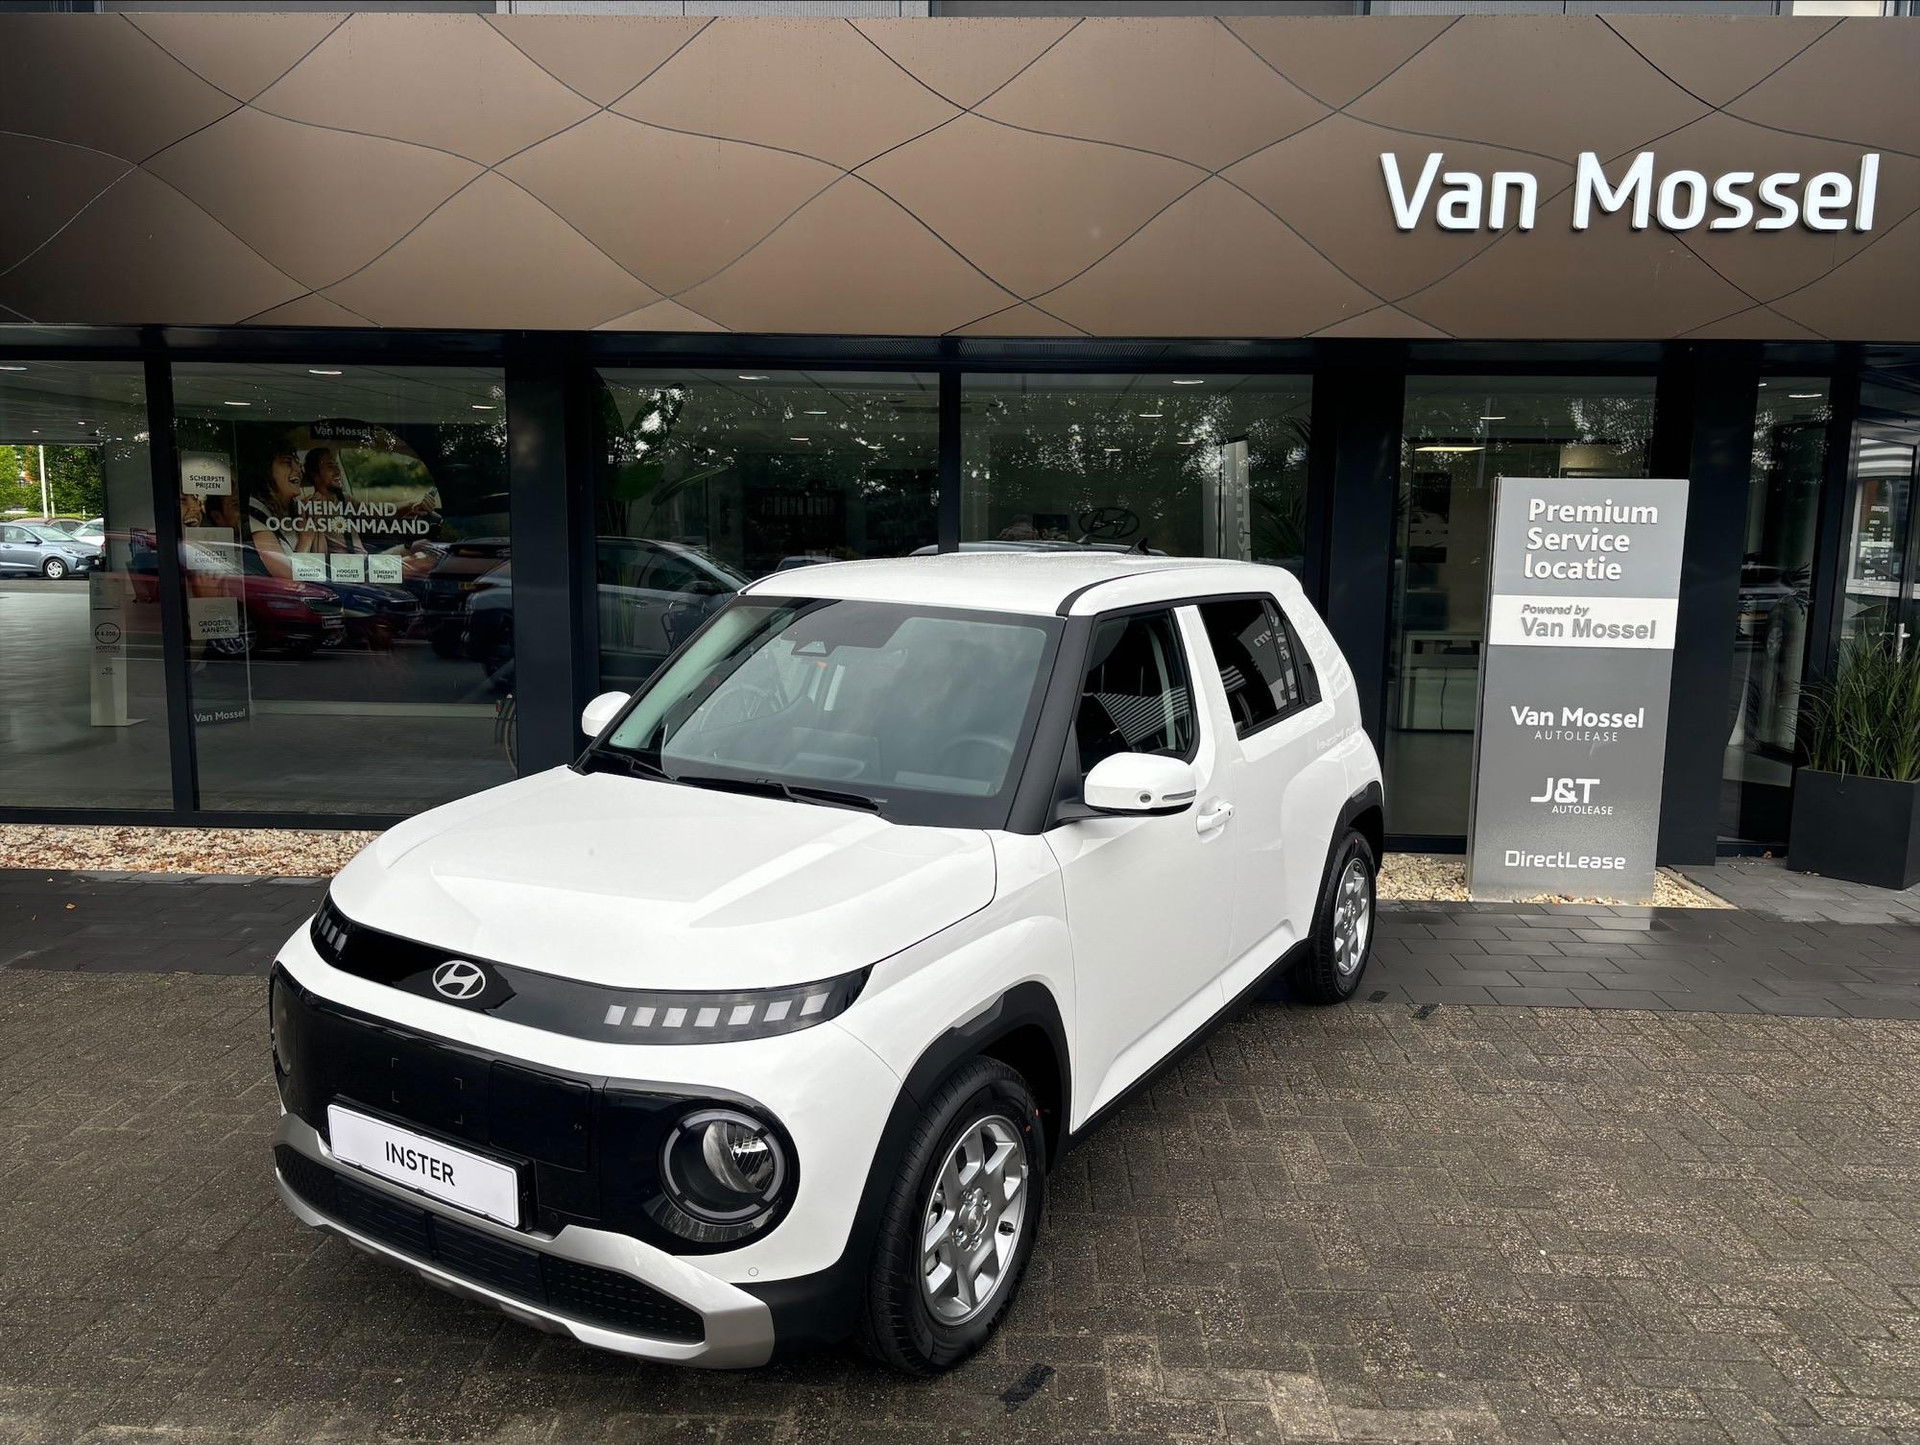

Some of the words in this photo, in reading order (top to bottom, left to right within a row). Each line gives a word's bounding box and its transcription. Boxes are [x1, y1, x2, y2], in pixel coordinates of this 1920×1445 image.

[1379, 152, 1537, 231] Van
[1572, 151, 1880, 232] Mossel
[314, 425, 333, 436] Van
[189, 474, 225, 482] SCHERPSTE
[195, 482, 221, 490] PRIJZEN
[297, 501, 397, 517] MEIMAAND
[1528, 498, 1658, 525] Premium
[265, 516, 430, 535] OCCASIONMAAND
[1526, 527, 1631, 552] Service
[1524, 553, 1623, 580] locatie
[1521, 604, 1572, 616] Powered
[1574, 604, 1590, 617] by
[1521, 617, 1564, 637] Van
[1571, 618, 1657, 639] Mossel
[194, 712, 213, 722] Van
[215, 708, 246, 720] Mossel
[1510, 706, 1554, 726] Van
[1561, 707, 1645, 729] Mossel
[1534, 730, 1619, 742] AUTOLEASE
[1530, 777, 1601, 804] J&T
[1551, 805, 1614, 815] AUTOLEASE
[1504, 850, 1627, 870] DirectLease
[385, 1140, 456, 1187] INSTER
